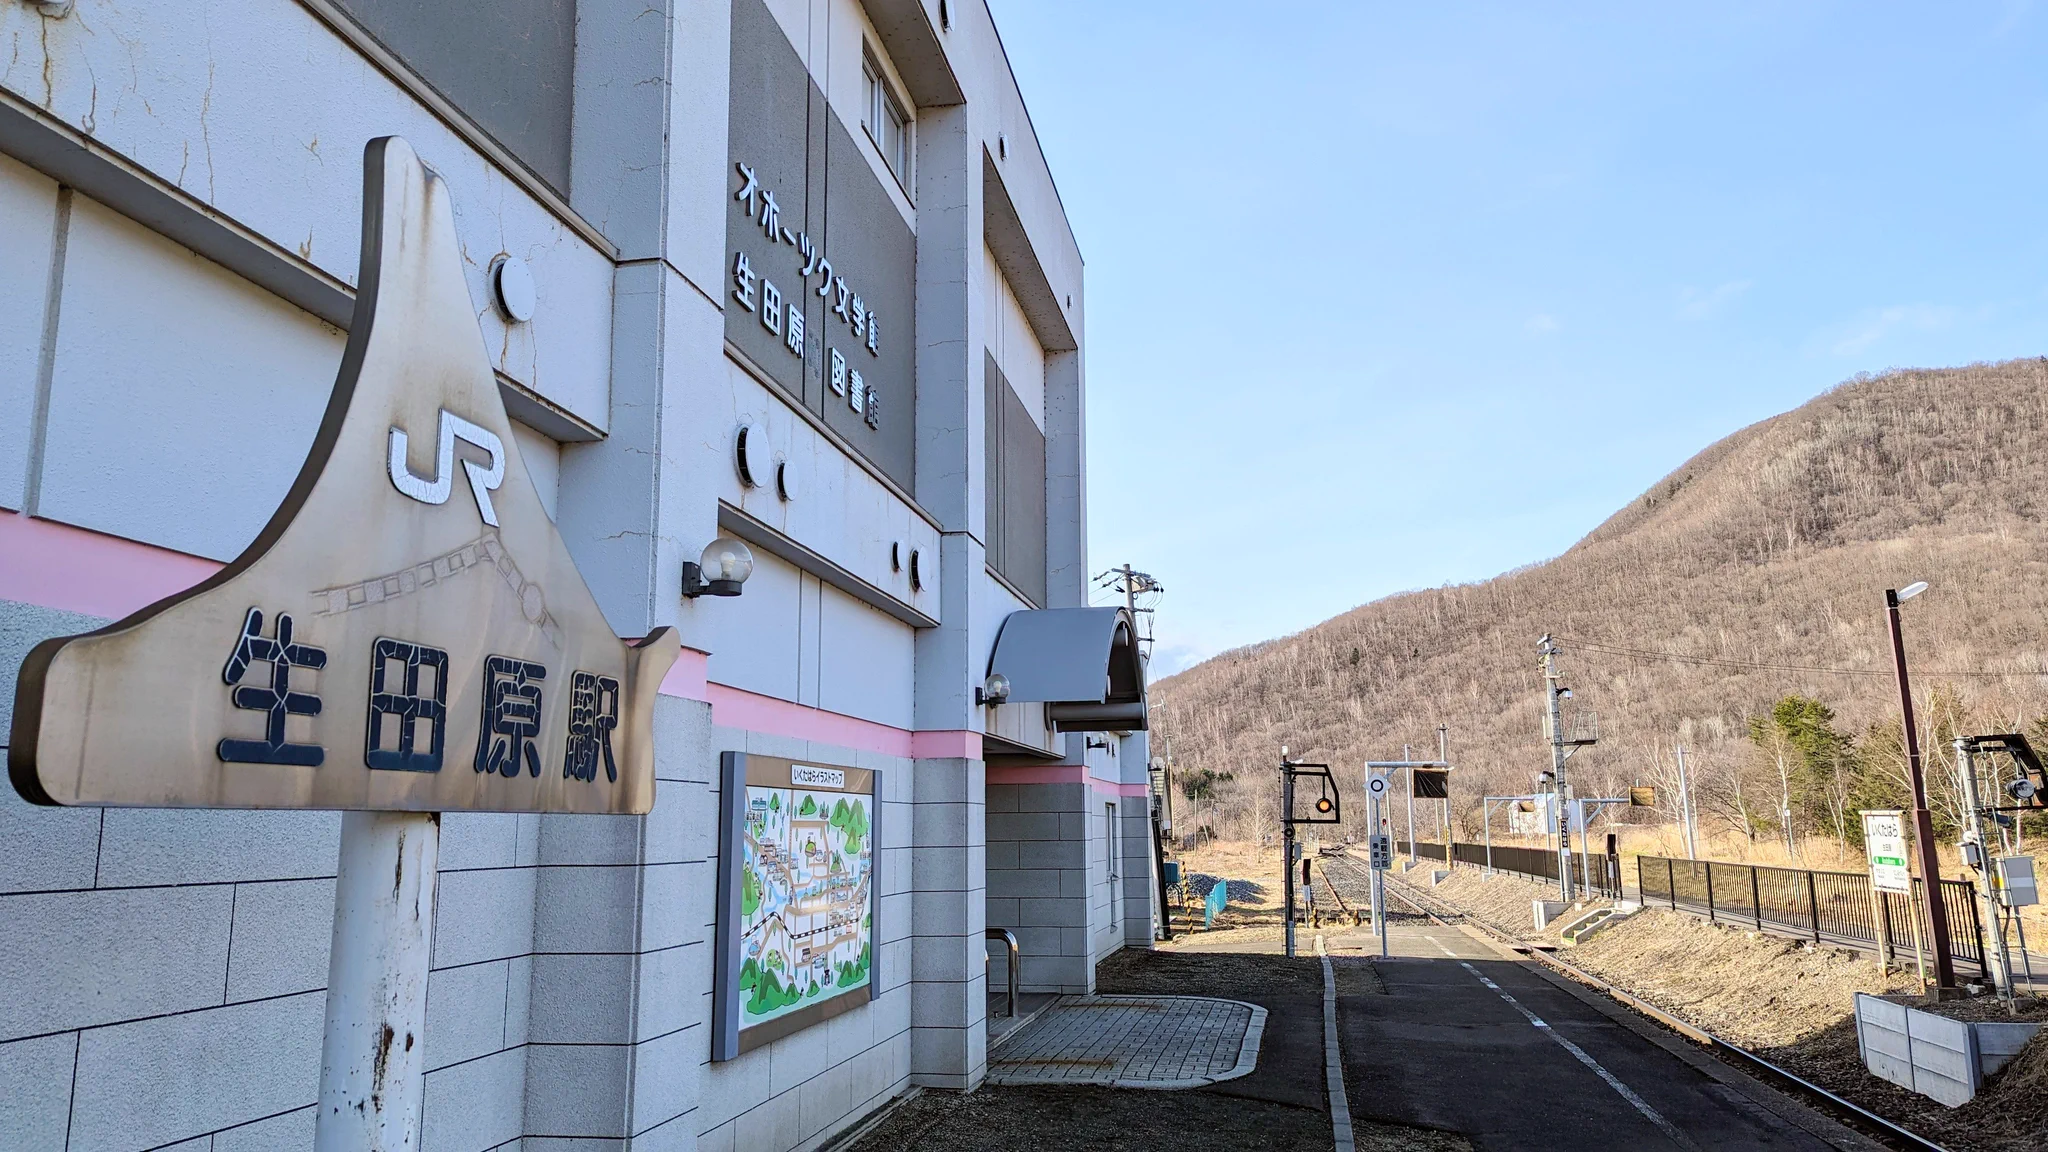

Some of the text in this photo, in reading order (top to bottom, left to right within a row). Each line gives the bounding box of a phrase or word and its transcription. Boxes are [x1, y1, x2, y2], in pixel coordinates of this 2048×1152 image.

[735, 162, 879, 357] オホーツク文学館
[732, 252, 879, 430] 生田原 図書館
[388, 408, 505, 527] JR
[217, 606, 618, 783] 生田原駅
[793, 769, 843, 785] いくたはらイラストマップ
[1871, 823, 1899, 838] いくたはら
